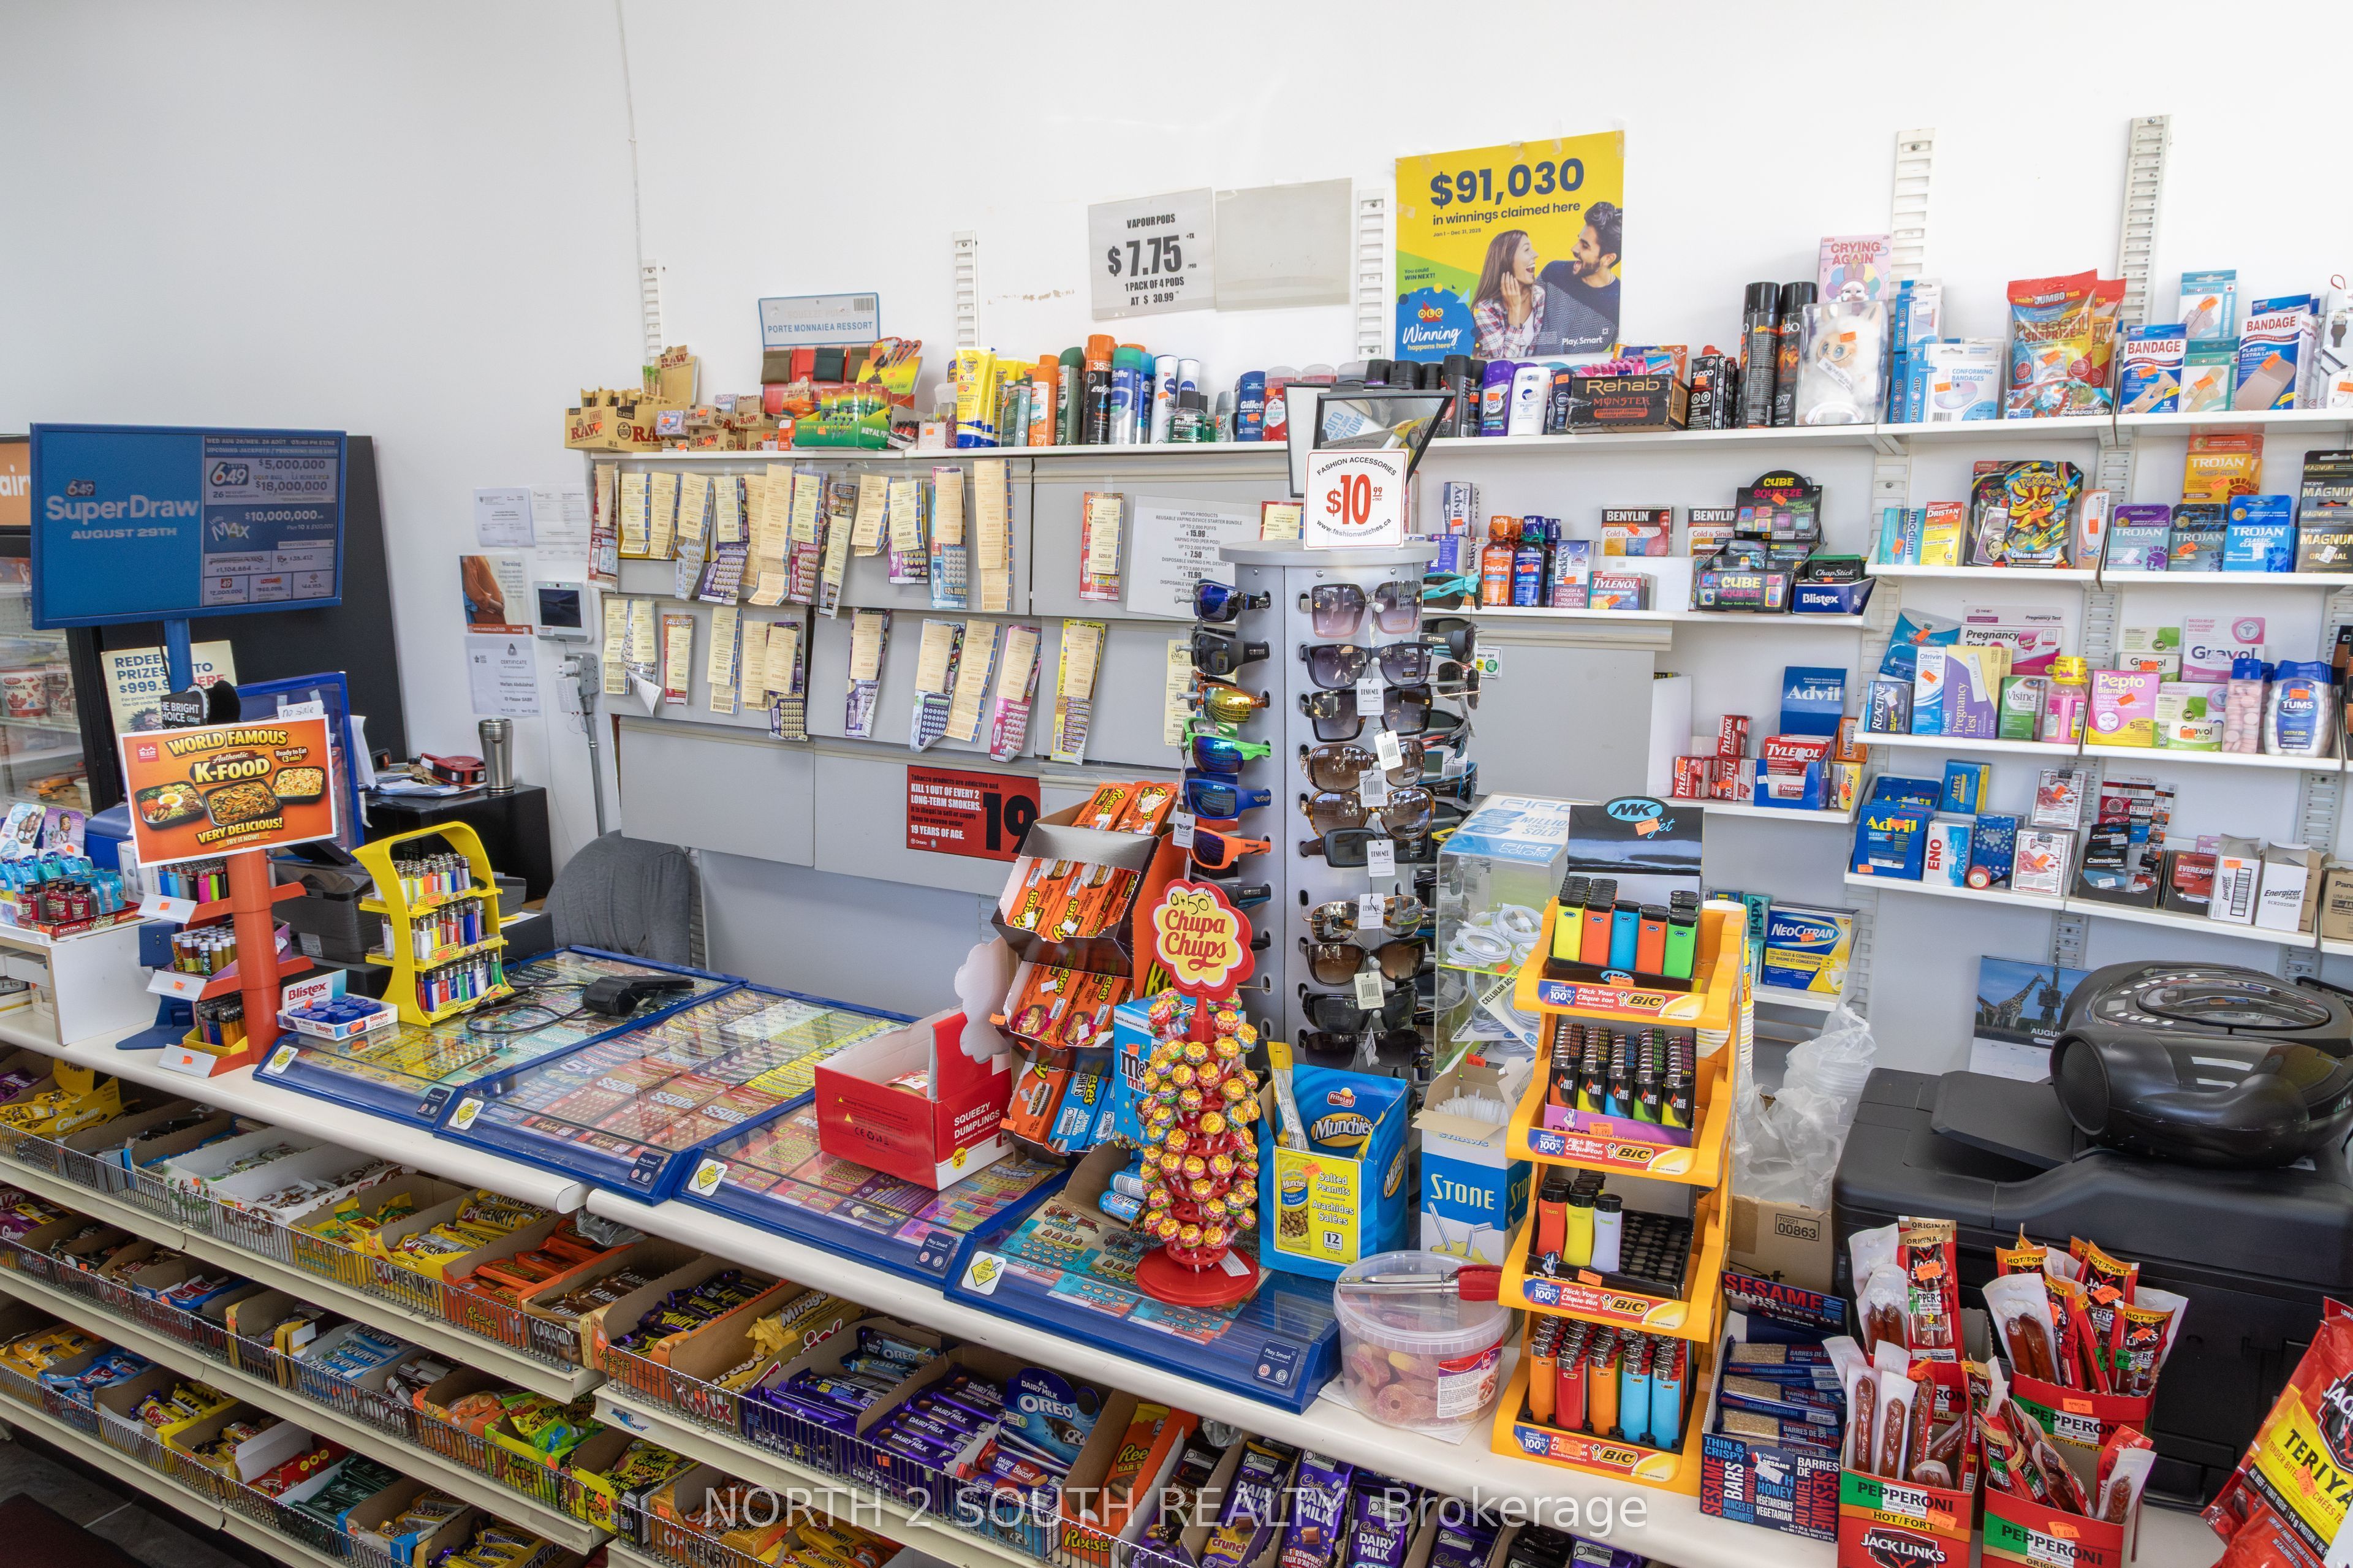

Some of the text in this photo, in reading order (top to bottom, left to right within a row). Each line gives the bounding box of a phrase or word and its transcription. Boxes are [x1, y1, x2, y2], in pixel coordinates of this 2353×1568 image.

[1430, 158, 1584, 210] $91,030
[1156, 213, 1175, 225] PODS
[1433, 202, 1581, 225] in winnings claimed here
[1830, 241, 1881, 254] CRYING
[1107, 235, 1183, 277] $ 7.75
[1832, 253, 1874, 265] AGAIN
[767, 324, 793, 333] PORTE
[838, 321, 873, 331] RESSORT
[2246, 316, 2297, 332] BANDAGE
[1403, 324, 1462, 345] Winning
[1408, 343, 1434, 352] happens
[2128, 340, 2181, 354] BANDAGE
[1586, 378, 1661, 395] Rehab
[259, 460, 325, 471] $5,000,000
[1317, 456, 1396, 477] FASHION ACCESSORIES
[2191, 458, 2245, 468] TROJAN
[256, 482, 327, 492] $18,000,000
[1764, 477, 1795, 487] CUBE
[1606, 511, 1649, 521] BENYLIN
[71, 527, 177, 540] AUGUST 29TH
[1316, 518, 1392, 537] www.fashionwatches.ca
[1908, 511, 1919, 556] Imodium
[2115, 528, 2162, 537] TROJAN
[2231, 527, 2285, 537] TROJAN
[1593, 578, 1637, 589] TYLENOL
[1721, 577, 1762, 588] CUBE
[1721, 589, 1760, 598] SQUEEZE
[1802, 594, 1839, 606] Blistex
[1966, 629, 2019, 640] Pregnancy
[193, 663, 213, 673] TO
[2098, 673, 2145, 689] Pepto
[1786, 685, 1842, 701] Advil
[2006, 690, 2035, 702] Visine
[1953, 683, 1969, 733] Pregnancy
[2283, 700, 2313, 710] TUMS
[1965, 714, 1977, 735] Test
[168, 730, 287, 755] WORLD FAMOUS
[1721, 718, 1733, 755] TYLENOL
[213, 752, 248, 763] Authentic
[194, 759, 270, 782] K-FOOD
[911, 783, 979, 799] KILL 1 OUT OF EVERY 2
[911, 795, 982, 811] LONG-TERM SMOKERS.
[199, 818, 283, 843] VERY DELICIOUS!
[911, 825, 919, 834] 19
[920, 826, 940, 836] YEARS
[950, 830, 964, 839] AGE.
[1499, 847, 1550, 857] COLORS
[1927, 839, 1942, 871] ENO
[2178, 865, 2213, 876] EVEREADY
[2264, 889, 2302, 898] Energizer
[1164, 909, 1226, 938] Chupa
[1164, 933, 1227, 971] Chups
[288, 982, 328, 1001] Blistex
[1481, 982, 1506, 1006] CELLULAR
[1577, 994, 1598, 1004] Clique
[1578, 988, 1596, 996] Flick
[369, 1012, 388, 1022] Blistex
[56, 1106, 101, 1132] Glosette
[953, 1102, 991, 1126] SQUEEZY
[953, 1108, 1000, 1139] DUMPLINGS
[1315, 1116, 1374, 1140] Munchies
[953, 1151, 966, 1161] AGES
[1318, 1172, 1348, 1185] Salted
[1316, 1182, 1351, 1197] Peanuts
[1430, 1173, 1495, 1211] STONE
[462, 1205, 517, 1227] OH HENRY!
[1311, 1200, 1354, 1216] Arachides
[1317, 1212, 1348, 1226] Salées
[1779, 1216, 1798, 1225] 70221
[1778, 1222, 1816, 1238] 00863
[1325, 1233, 1340, 1245] 12
[2088, 1252, 2129, 1276] HOT/FORT
[1724, 1273, 1822, 1310] SESAME
[1724, 1288, 1776, 1307] BARS
[779, 1291, 828, 1327] Mirage
[882, 1348, 915, 1362] OREO
[1021, 1381, 1058, 1399] DAIRY MILK
[1018, 1393, 1075, 1420] OREO
[1705, 1437, 1744, 1453] THIN &
[1705, 1447, 1745, 1462] CRISPY
[637, 1456, 667, 1472] SOUR
[1797, 1457, 1840, 1472] BARRES
[1797, 1467, 1811, 1478] DE
[1702, 1456, 1724, 1516] SESAME
[1724, 1462, 1744, 1501] BARS
[1757, 1482, 1793, 1499] HONEY
[1857, 1482, 1953, 1513] PEPPERONI
[1723, 1498, 1754, 1513] MINCES ET
[1756, 1494, 1793, 1511] VÉGÉTARIENNES
[1795, 1480, 1811, 1526] AU MIEL
[1722, 1508, 1754, 1523] CROQUANTES
[1756, 1506, 1792, 1522] VEGETARIAN
[1873, 1511, 1934, 1531] HOT/FORT
[1358, 1534, 1397, 1551] DAIRY
[1861, 1533, 1946, 1562] JACK LINK'S
[2001, 1524, 2103, 1566] PEPPERONI
[1360, 1545, 1389, 1562] MILK
